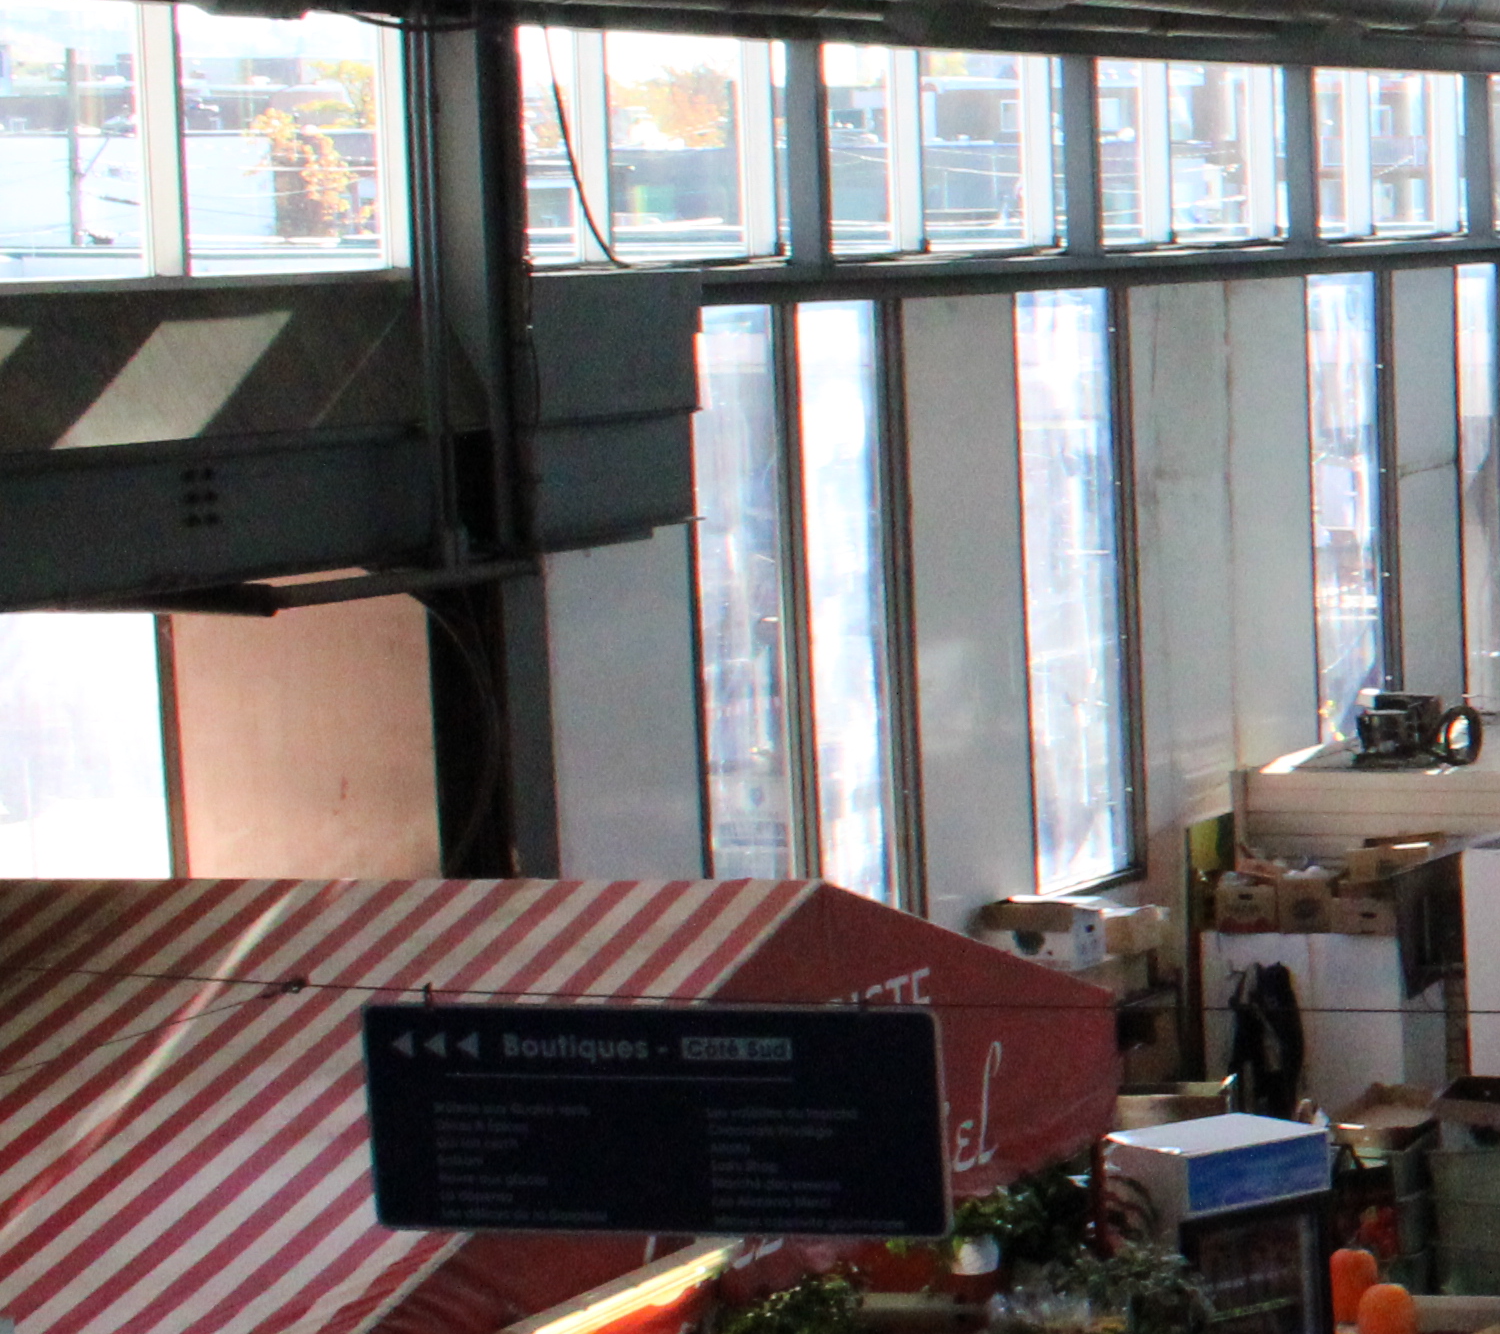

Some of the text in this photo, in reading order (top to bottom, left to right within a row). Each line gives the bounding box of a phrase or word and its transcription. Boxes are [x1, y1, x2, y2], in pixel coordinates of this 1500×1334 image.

[502, 1033, 788, 1064] Boutiques Côté Sud
